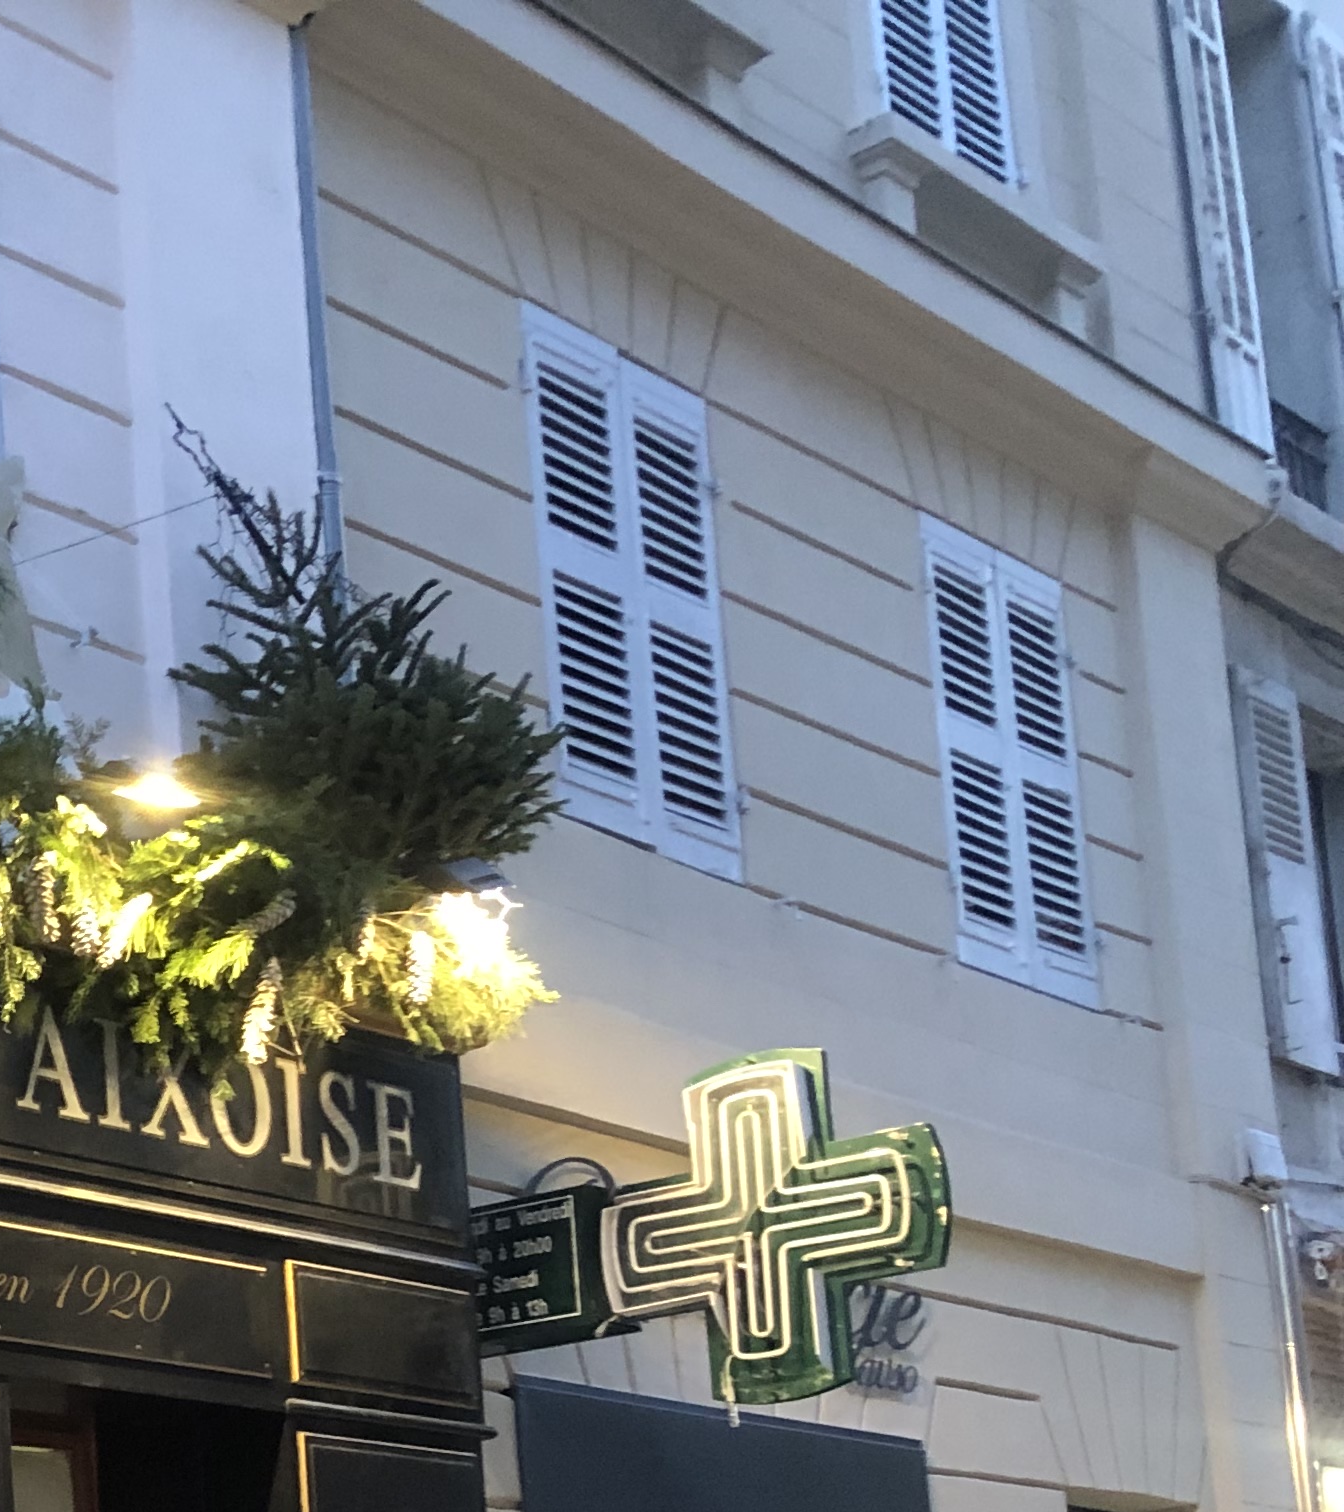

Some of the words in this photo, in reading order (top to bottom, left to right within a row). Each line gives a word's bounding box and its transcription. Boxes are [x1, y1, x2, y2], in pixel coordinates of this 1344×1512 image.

[16, 1004, 422, 1190] AIXOISE
[54, 1264, 173, 1323] 1920
[493, 1270, 539, 1293] Samedi
